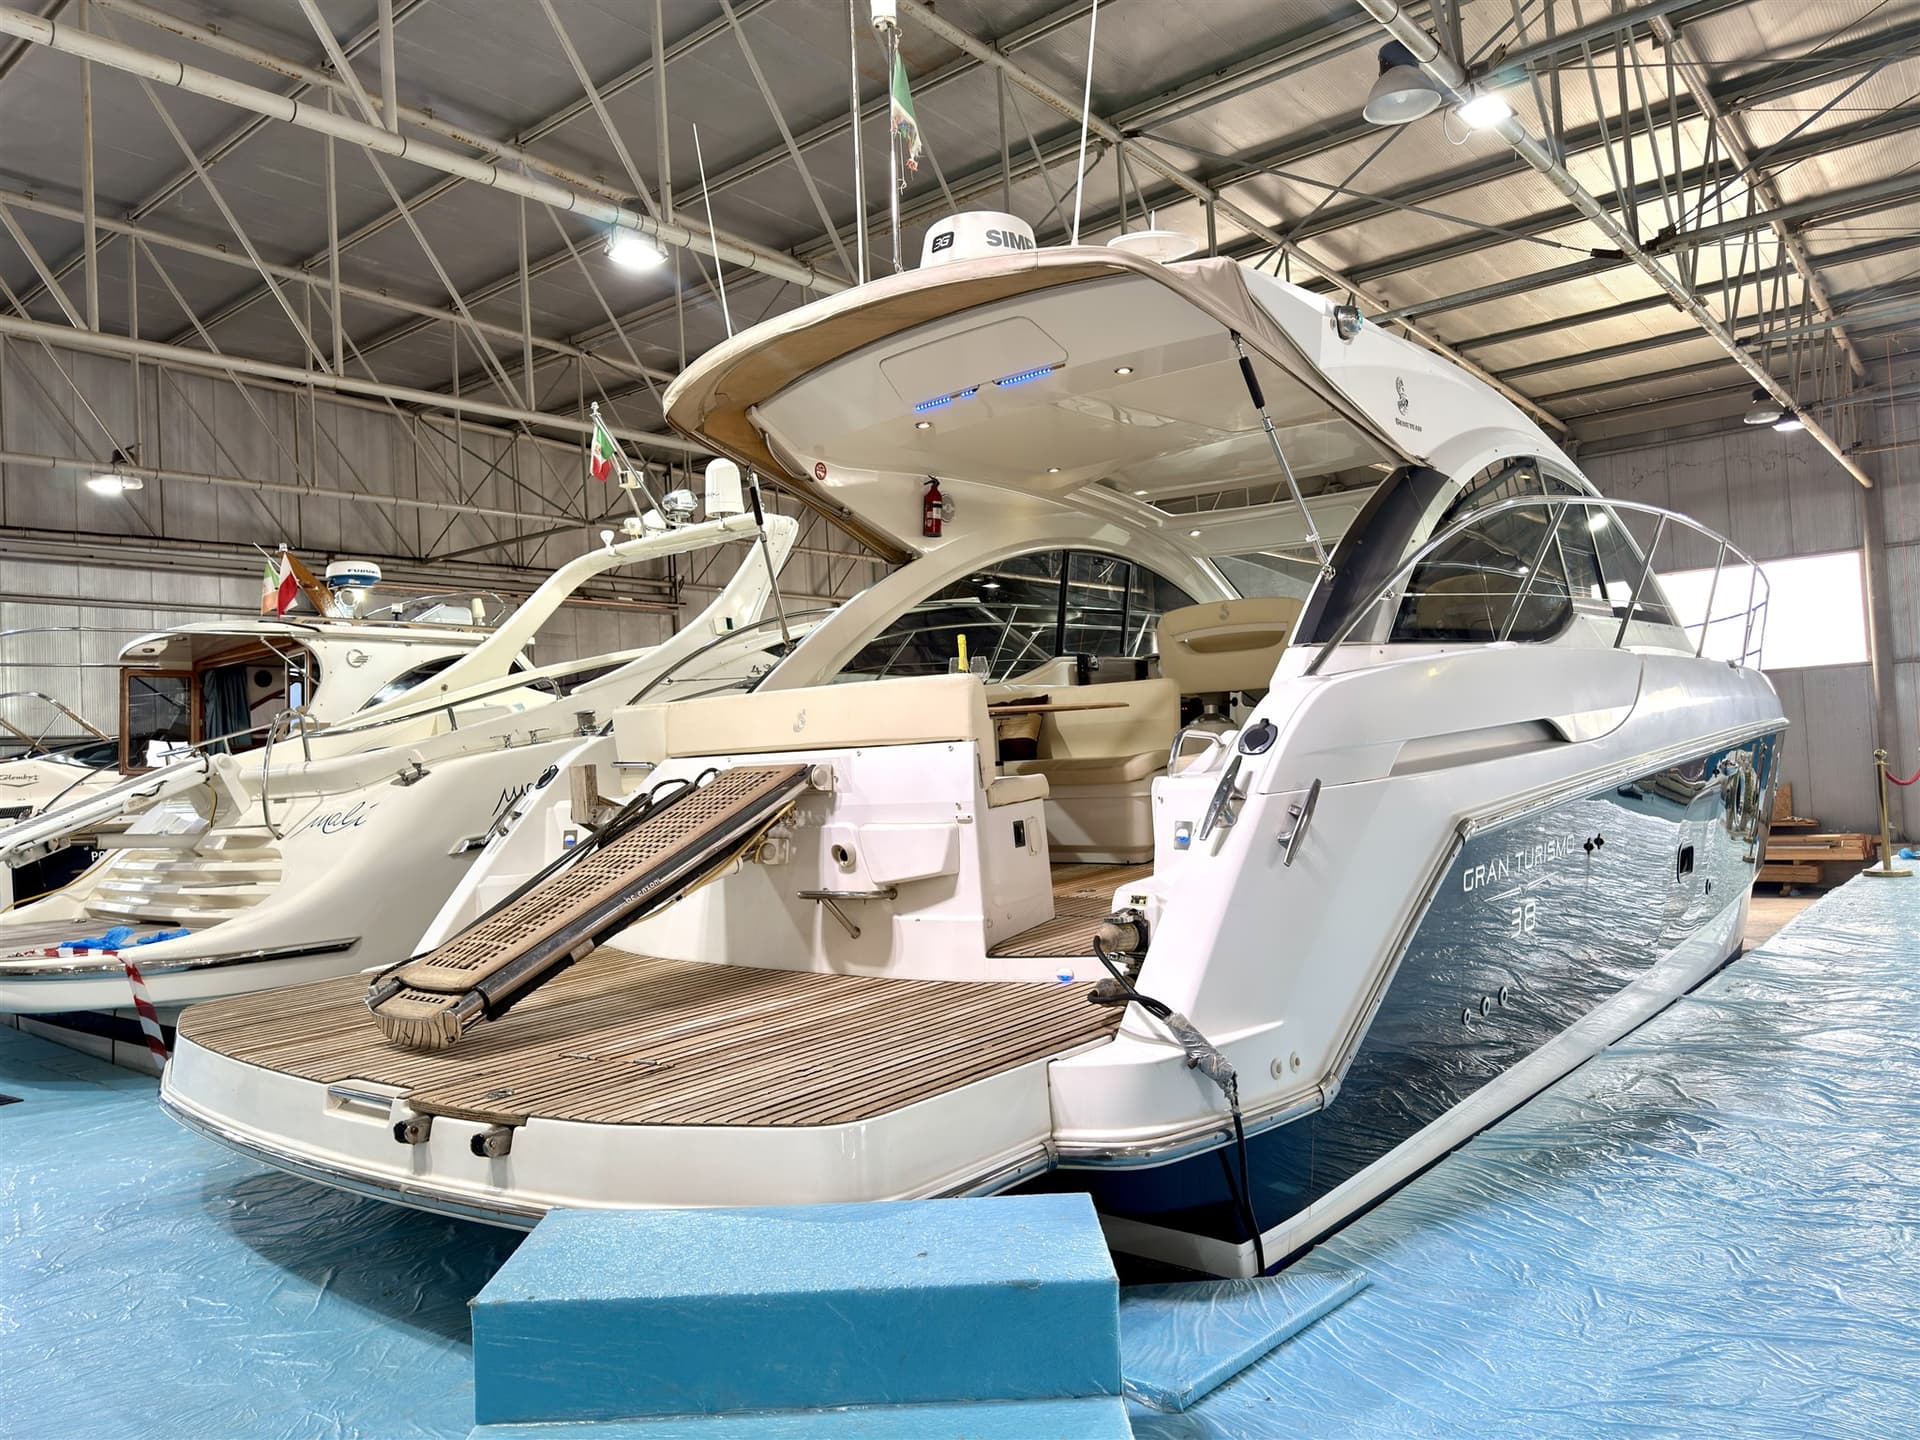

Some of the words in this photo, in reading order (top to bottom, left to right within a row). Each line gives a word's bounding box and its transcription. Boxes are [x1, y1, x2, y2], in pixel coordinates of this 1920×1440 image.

[1463, 855, 1509, 892] GRAN
[1515, 833, 1575, 873] TURISMO
[1511, 901, 1536, 938] 38
